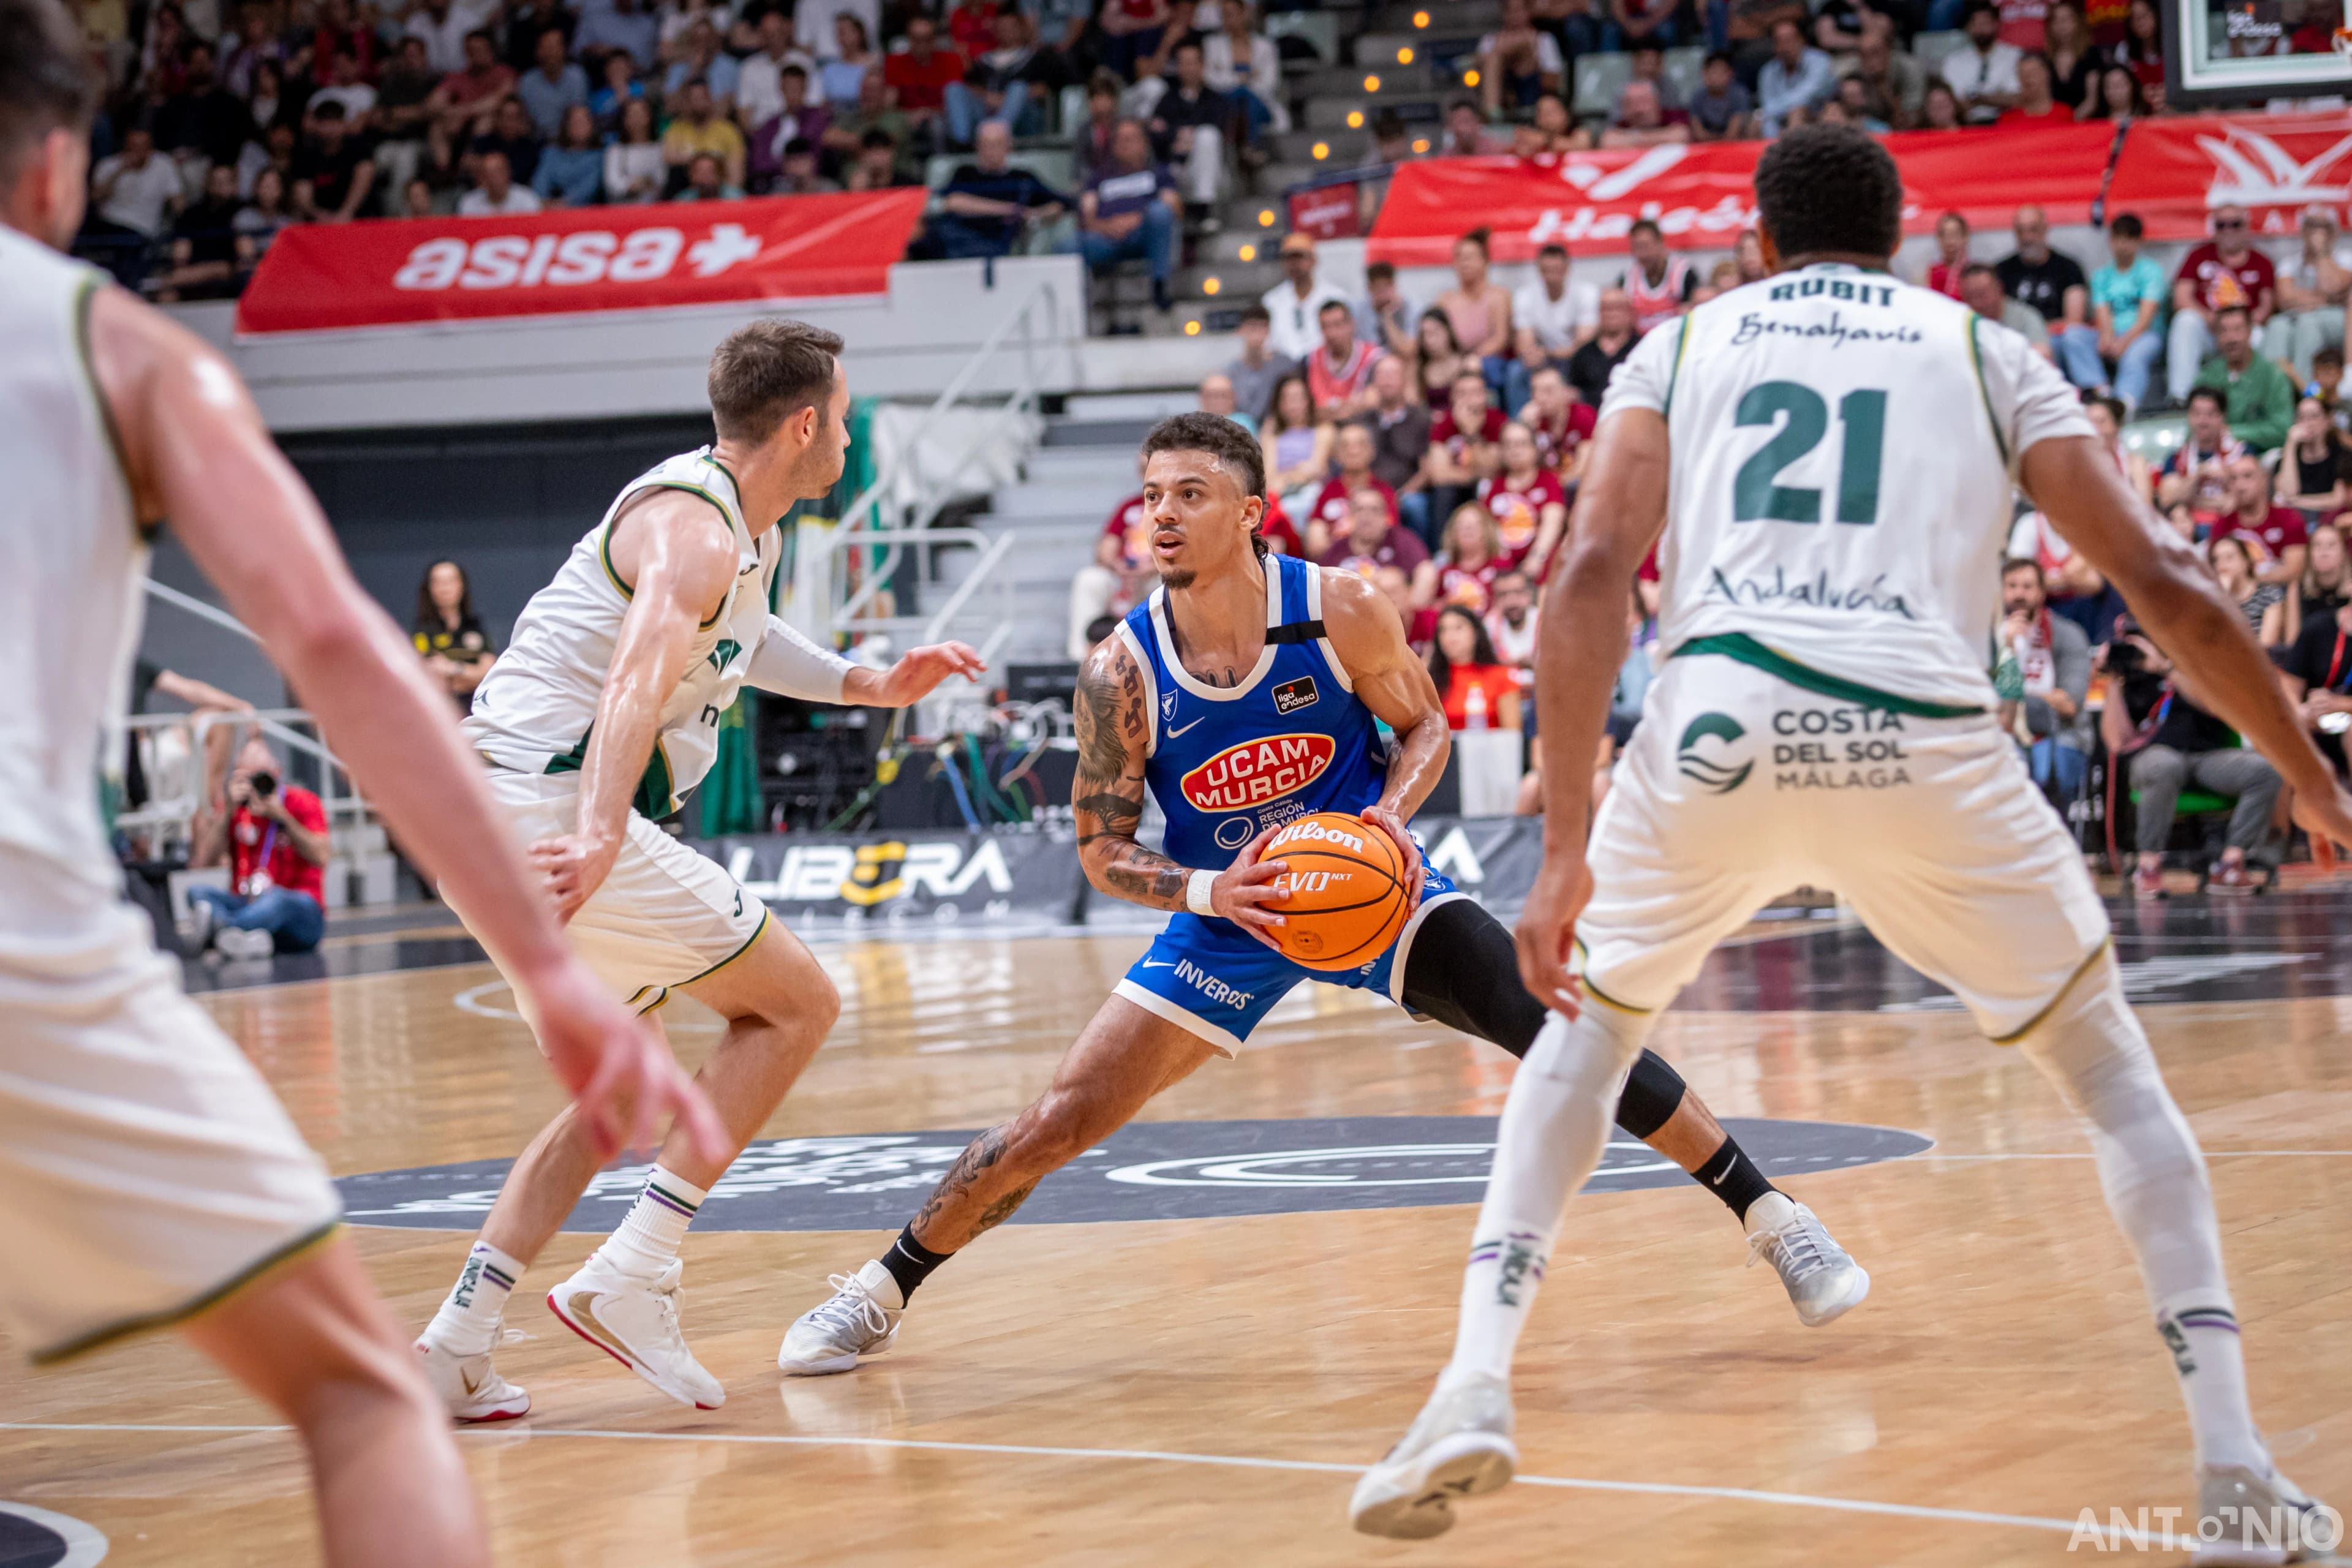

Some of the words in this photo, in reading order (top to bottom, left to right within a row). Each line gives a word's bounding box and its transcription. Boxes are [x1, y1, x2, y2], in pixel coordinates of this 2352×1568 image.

[393, 227, 683, 290] asisa
[1770, 278, 1895, 307] RUBIT
[1733, 380, 1888, 524] 21
[1704, 565, 1916, 620] Andalucía
[1278, 692, 1295, 703] liga
[1281, 693, 1315, 709] endesa
[1772, 708, 1905, 736] COSTA
[1206, 739, 1310, 786] UCAM
[1773, 742, 1836, 764] DEL
[1846, 738, 1910, 763] SOL
[1195, 754, 1326, 807] MURCIA
[1774, 766, 1912, 790] MÁLAGA
[1257, 805, 1273, 814] Costa
[1259, 801, 1305, 824] REGIÓN
[1268, 821, 1365, 853] Wilson
[728, 838, 1014, 906] LIBERA
[1174, 958, 1251, 1010] INVEROS
